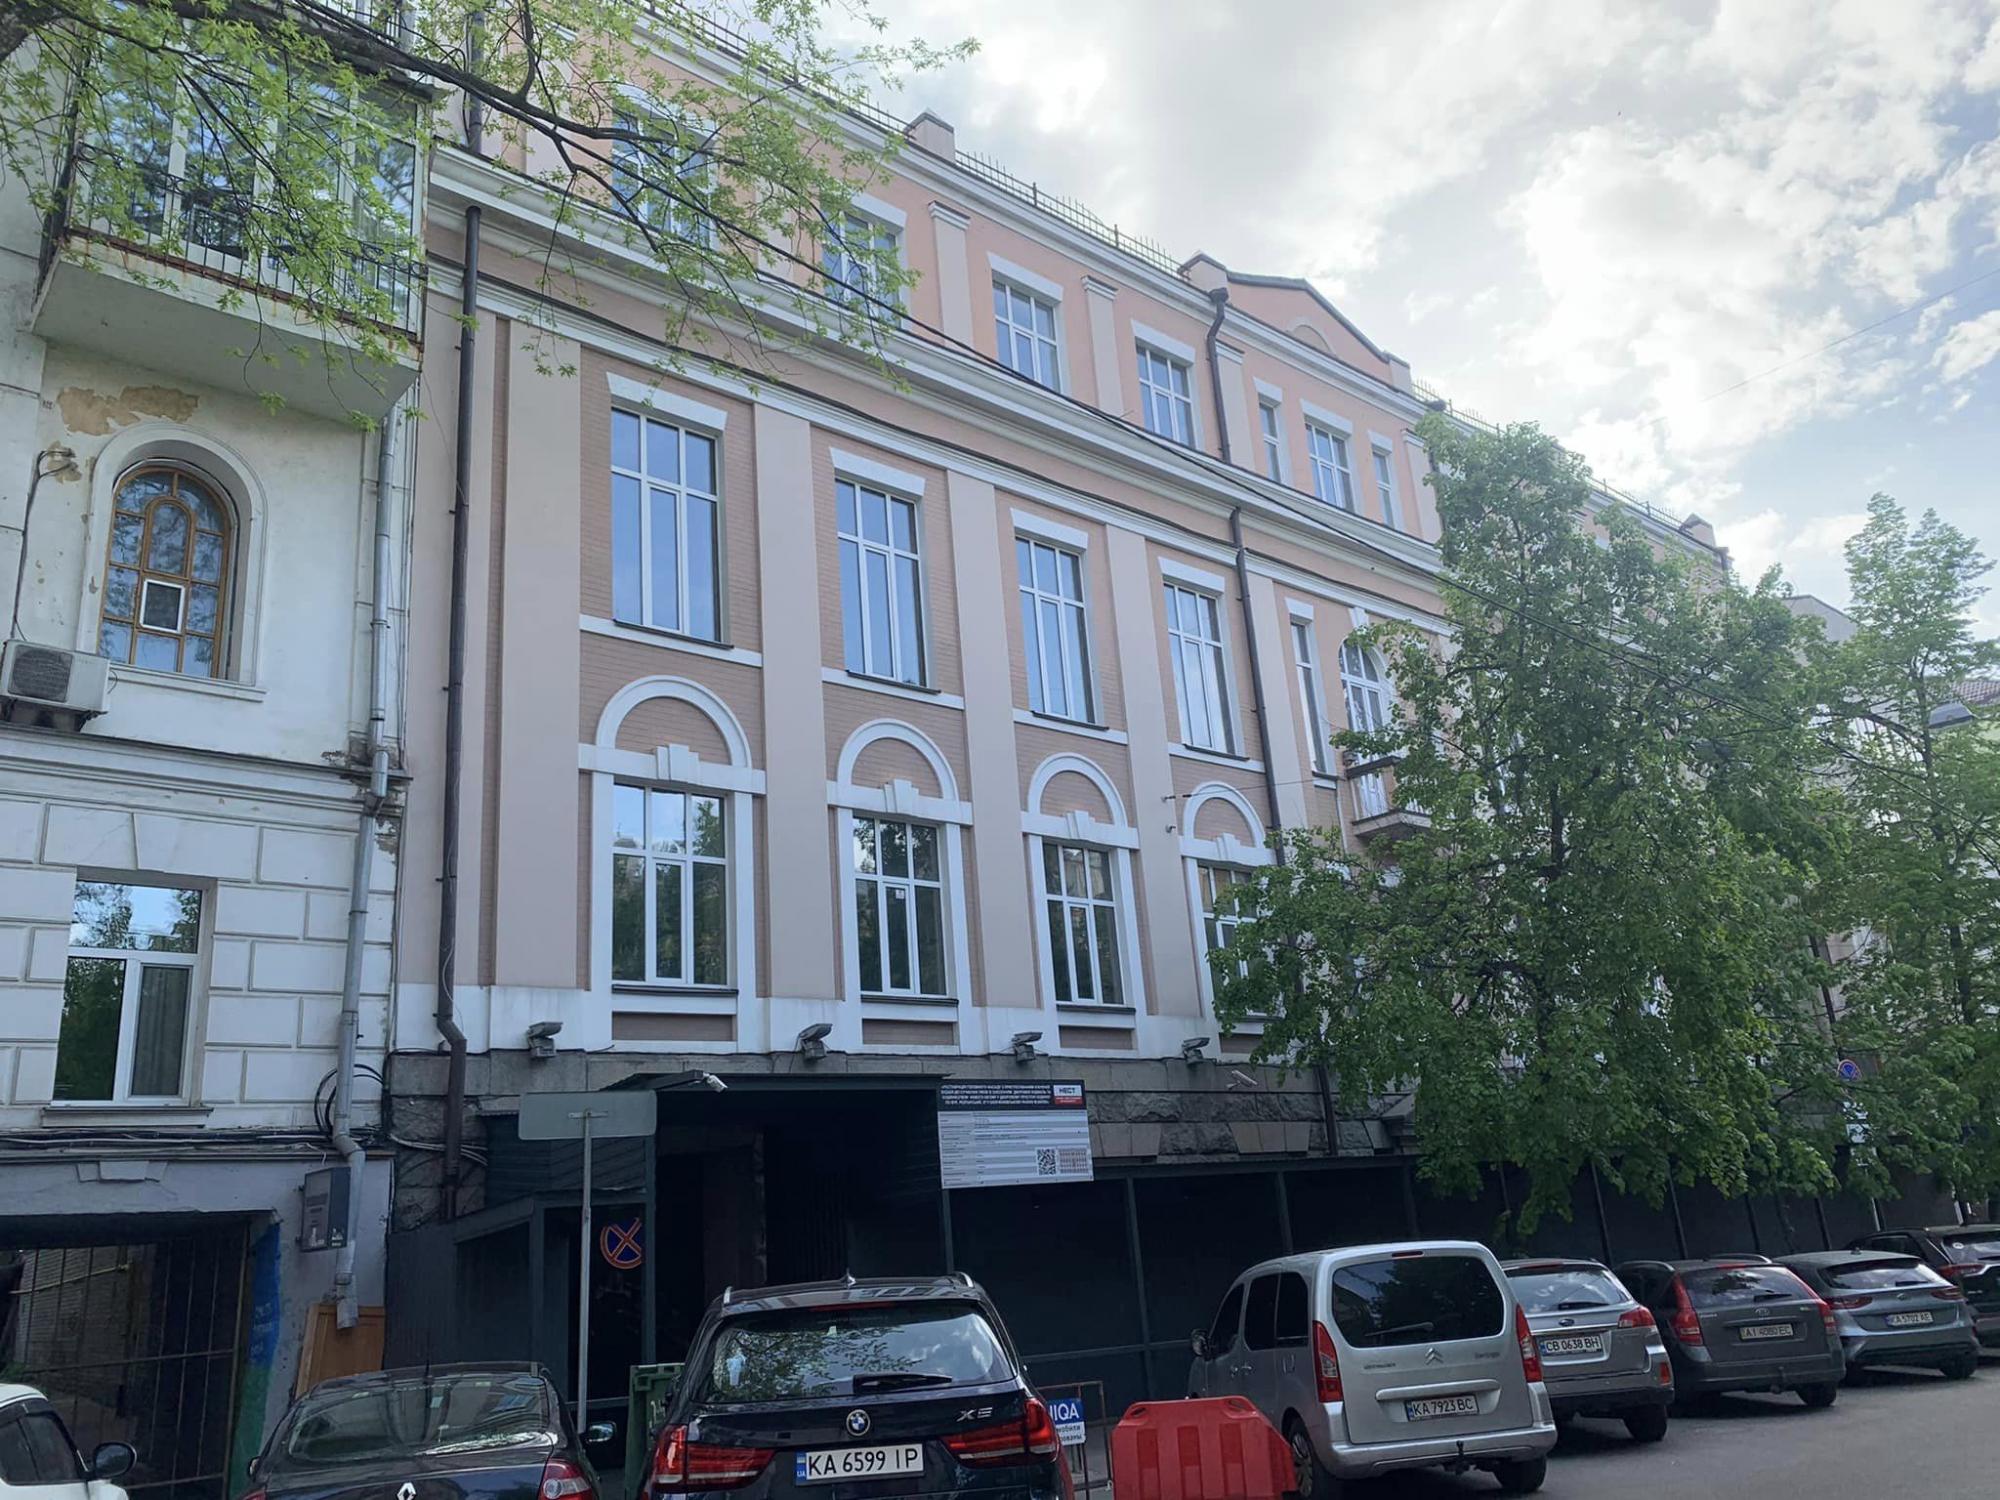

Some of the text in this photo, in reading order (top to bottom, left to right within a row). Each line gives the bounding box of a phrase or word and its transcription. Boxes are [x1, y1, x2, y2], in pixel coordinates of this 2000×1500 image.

[1546, 1336, 1599, 1351] CB 0638 BH
[1050, 1403, 1079, 1420] IQA
[1413, 1398, 1474, 1416] KA 7923 BC
[808, 1447, 918, 1477] KA 6599 IP
